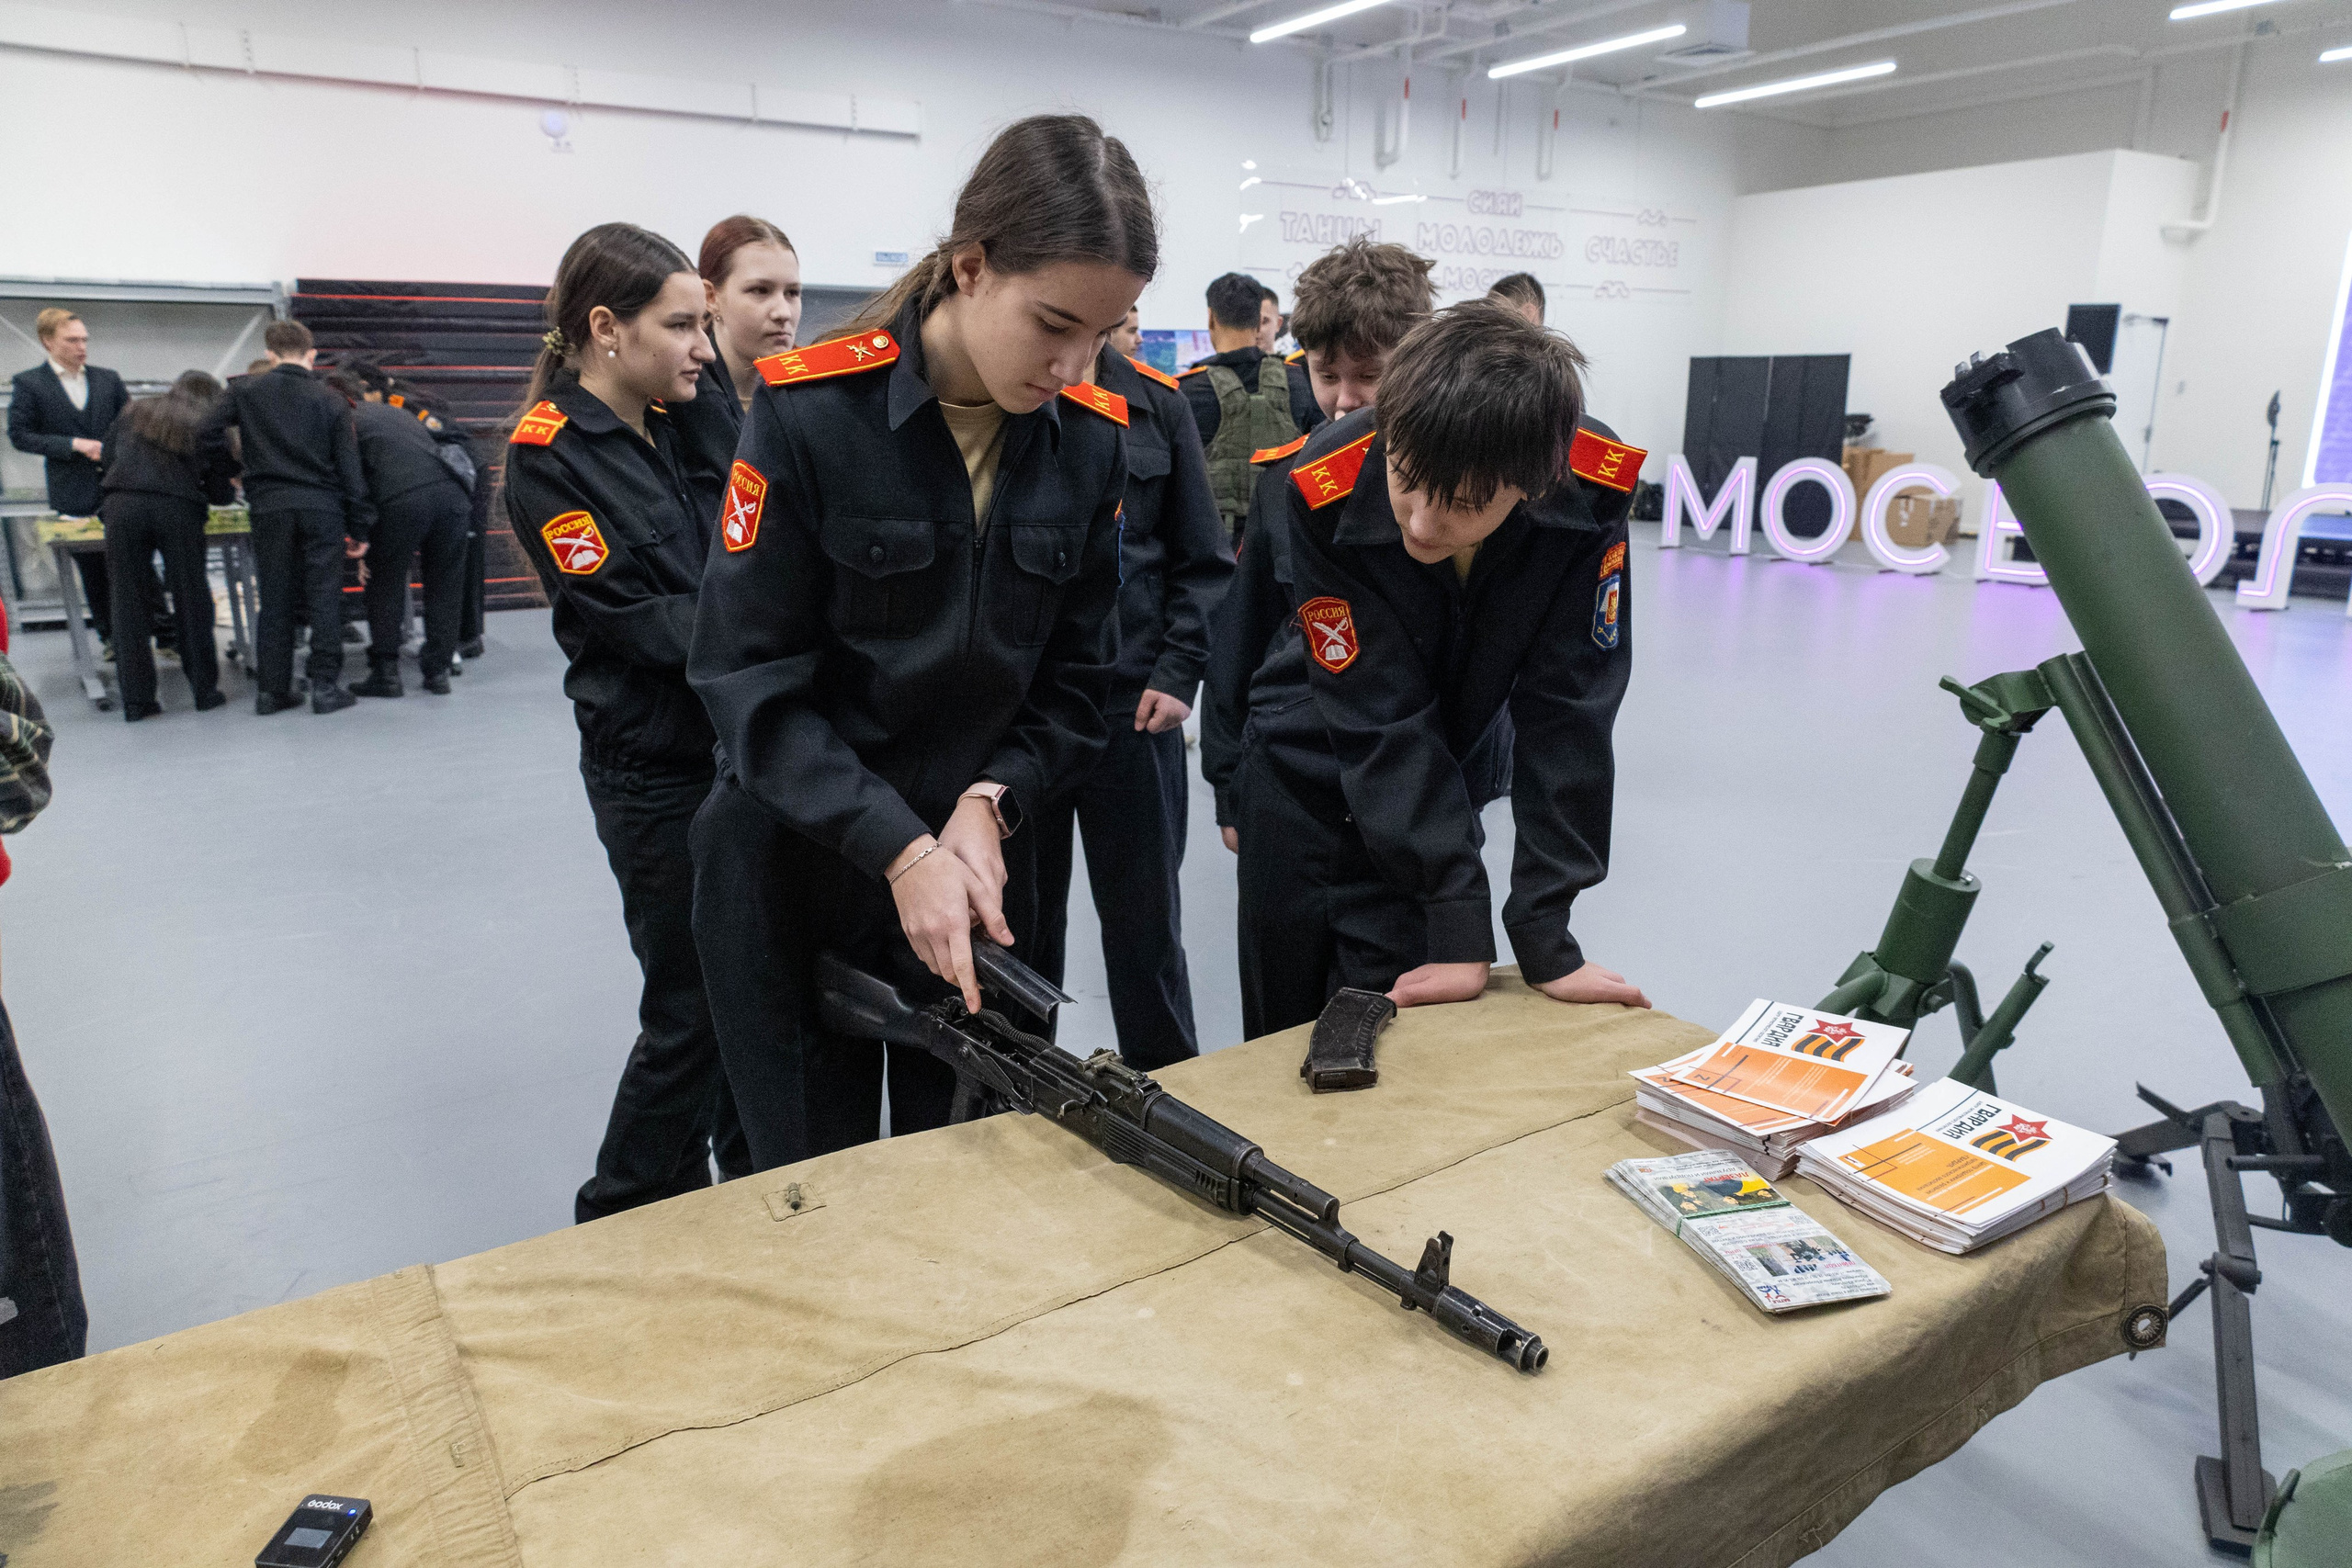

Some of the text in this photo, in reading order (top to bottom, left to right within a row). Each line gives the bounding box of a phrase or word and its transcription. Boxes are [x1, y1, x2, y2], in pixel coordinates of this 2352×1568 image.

[1279, 210, 1679, 267] ТАНЦЫ МОЛОДЕЖЬ СЧАСТЬЕ
[778, 354, 808, 376] КК
[1091, 388, 1111, 412] КК
[521, 423, 550, 435] КК
[1598, 448, 1625, 479] КК
[1311, 466, 1338, 496] КК
[546, 516, 593, 540] РОССИЯ
[1307, 606, 1346, 621] РОССИЯ
[1761, 1012, 1804, 1047] ГВАРДИЯ
[1942, 1104, 2002, 1139] ГВАРДИЯ
